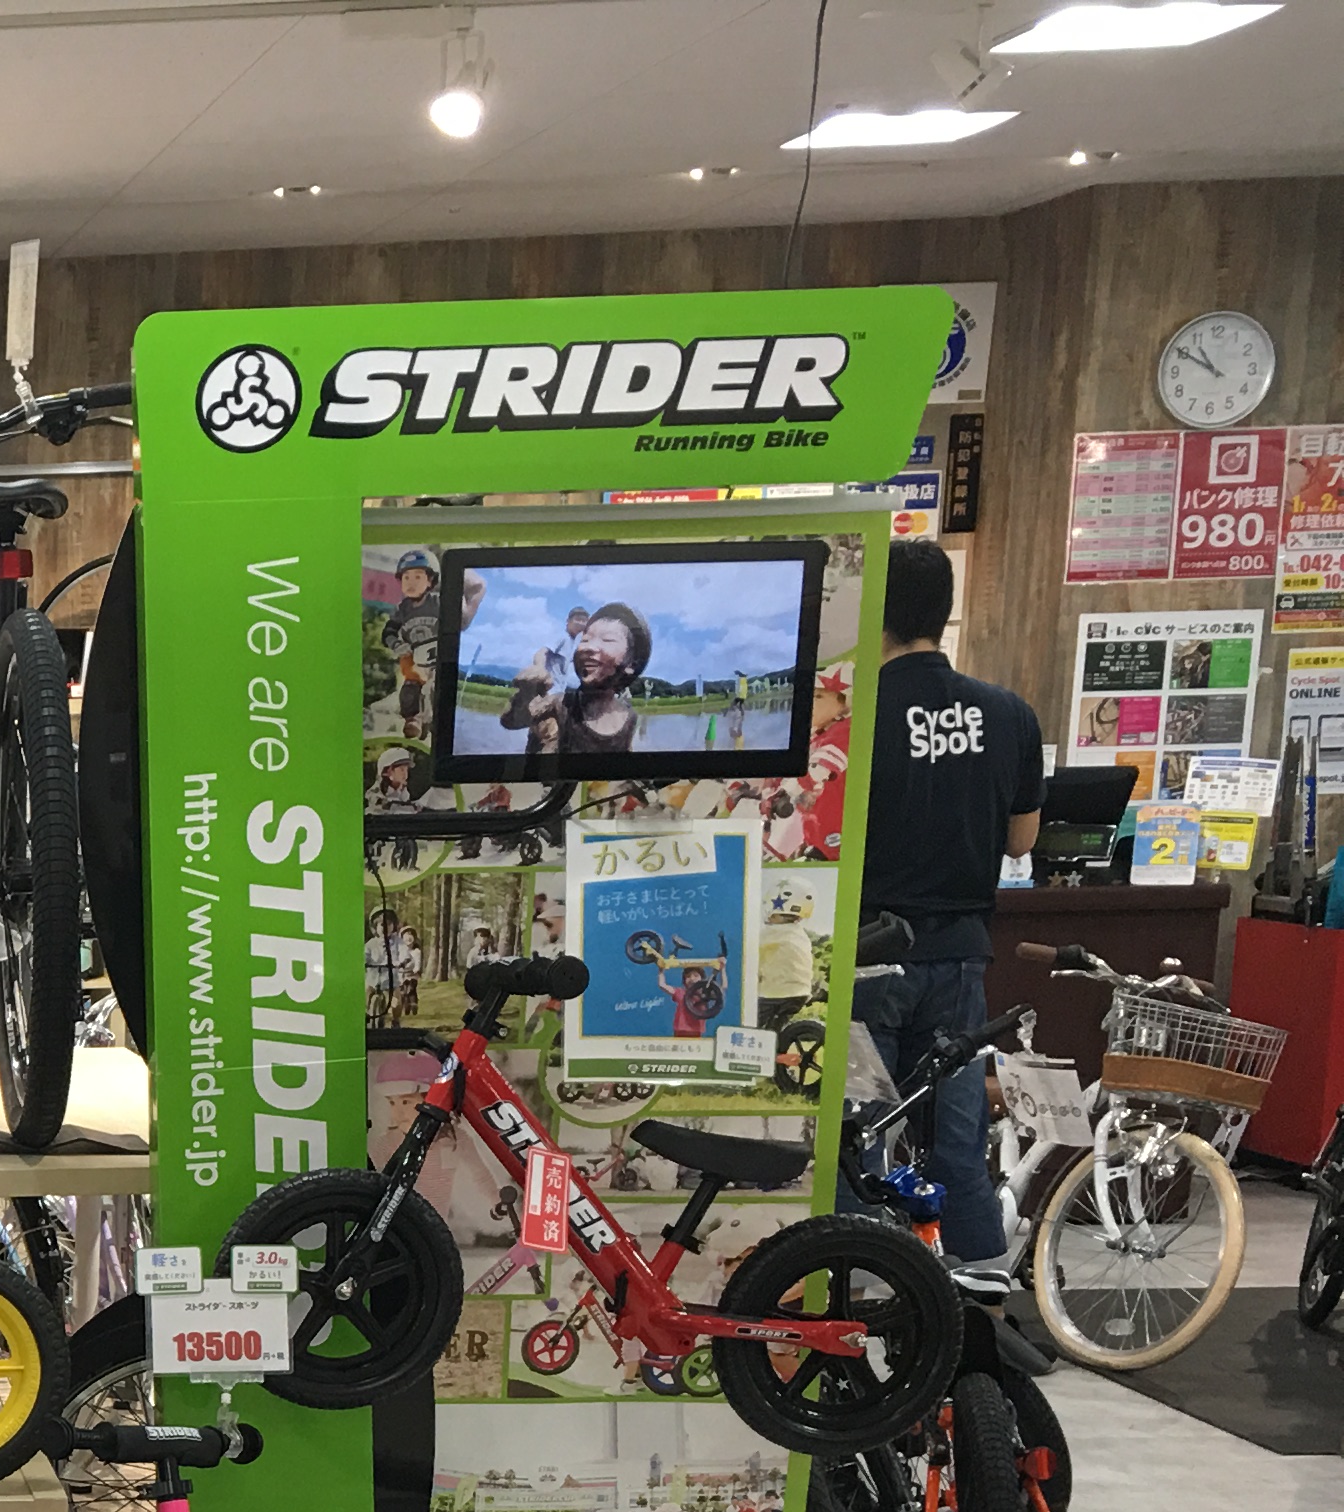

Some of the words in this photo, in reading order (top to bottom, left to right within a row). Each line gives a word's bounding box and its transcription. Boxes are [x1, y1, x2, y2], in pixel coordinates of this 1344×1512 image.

[1192, 332, 1203, 345] 11
[1211, 325, 1225, 339] 12
[1243, 343, 1253, 356] 2
[1171, 365, 1179, 379] 9
[1247, 362, 1257, 375] 3
[309, 333, 851, 440] STRIDER
[1174, 384, 1184, 398] 8
[1239, 382, 1248, 395] 4
[1188, 398, 1197, 411] 7
[1205, 402, 1214, 415] 6
[1224, 396, 1234, 409] 5
[635, 432, 755, 453] Running
[764, 428, 829, 450] Bike
[1183, 486, 1279, 509] パンク修理
[246, 556, 300, 658] We
[1289, 687, 1341, 699] ONLINE
[246, 675, 290, 772] are
[907, 702, 983, 733] Cycle
[910, 724, 984, 764] Spot
[593, 840, 708, 875] かるい
[597, 885, 710, 906] お子さまにとって
[176, 771, 226, 1187] http://www.strider.jp
[245, 802, 330, 1199] STRIDE
[641, 1064, 697, 1074] STRIDER
[543, 1166, 563, 1243] 売約済
[255, 1251, 288, 1266] 3.0kg
[184, 1302, 227, 1311] ストライダー
[229, 1301, 259, 1310] スポーツ
[749, 1327, 790, 1338] SPORT
[172, 1330, 262, 1362] 13500
[146, 1423, 202, 1441] STRIDER
